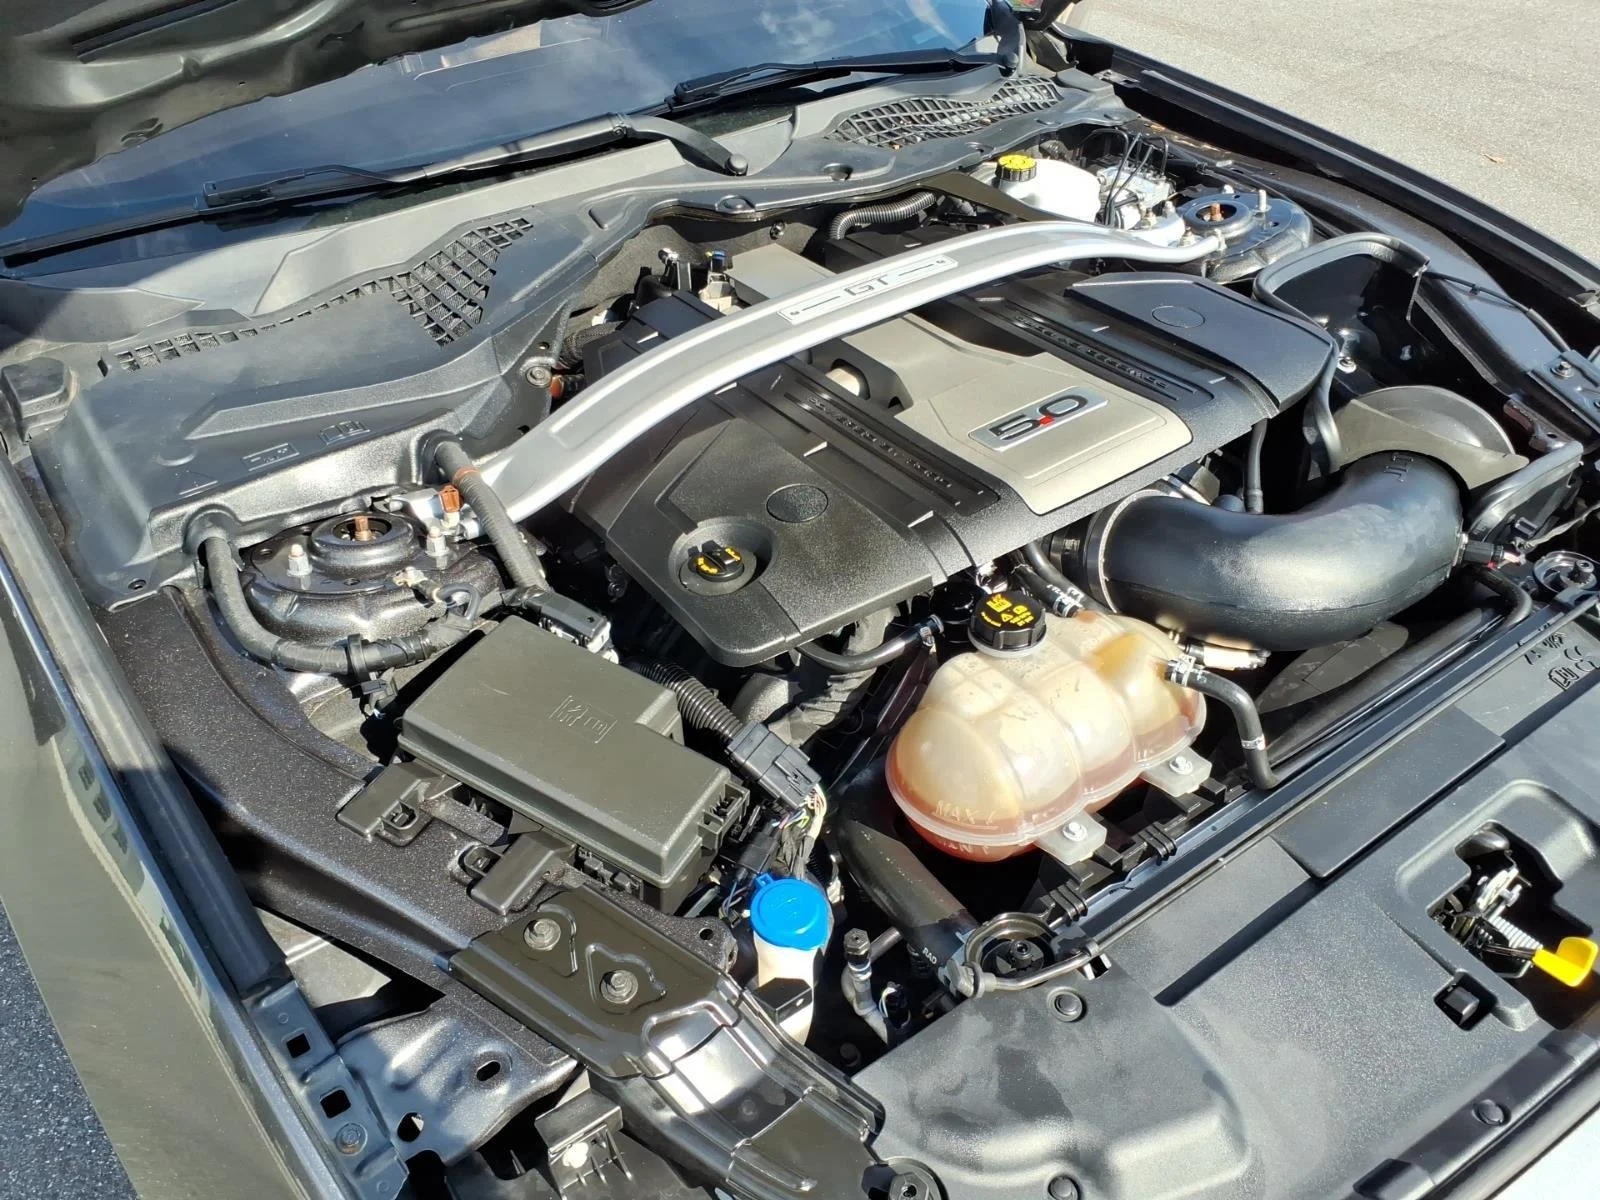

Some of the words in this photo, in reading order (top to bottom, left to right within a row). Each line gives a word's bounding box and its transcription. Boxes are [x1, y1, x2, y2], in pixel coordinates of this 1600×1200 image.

[844, 273, 888, 296] GT
[988, 394, 1089, 441] 5.0
[935, 800, 979, 825] MAX
[922, 947, 938, 965] RAD
